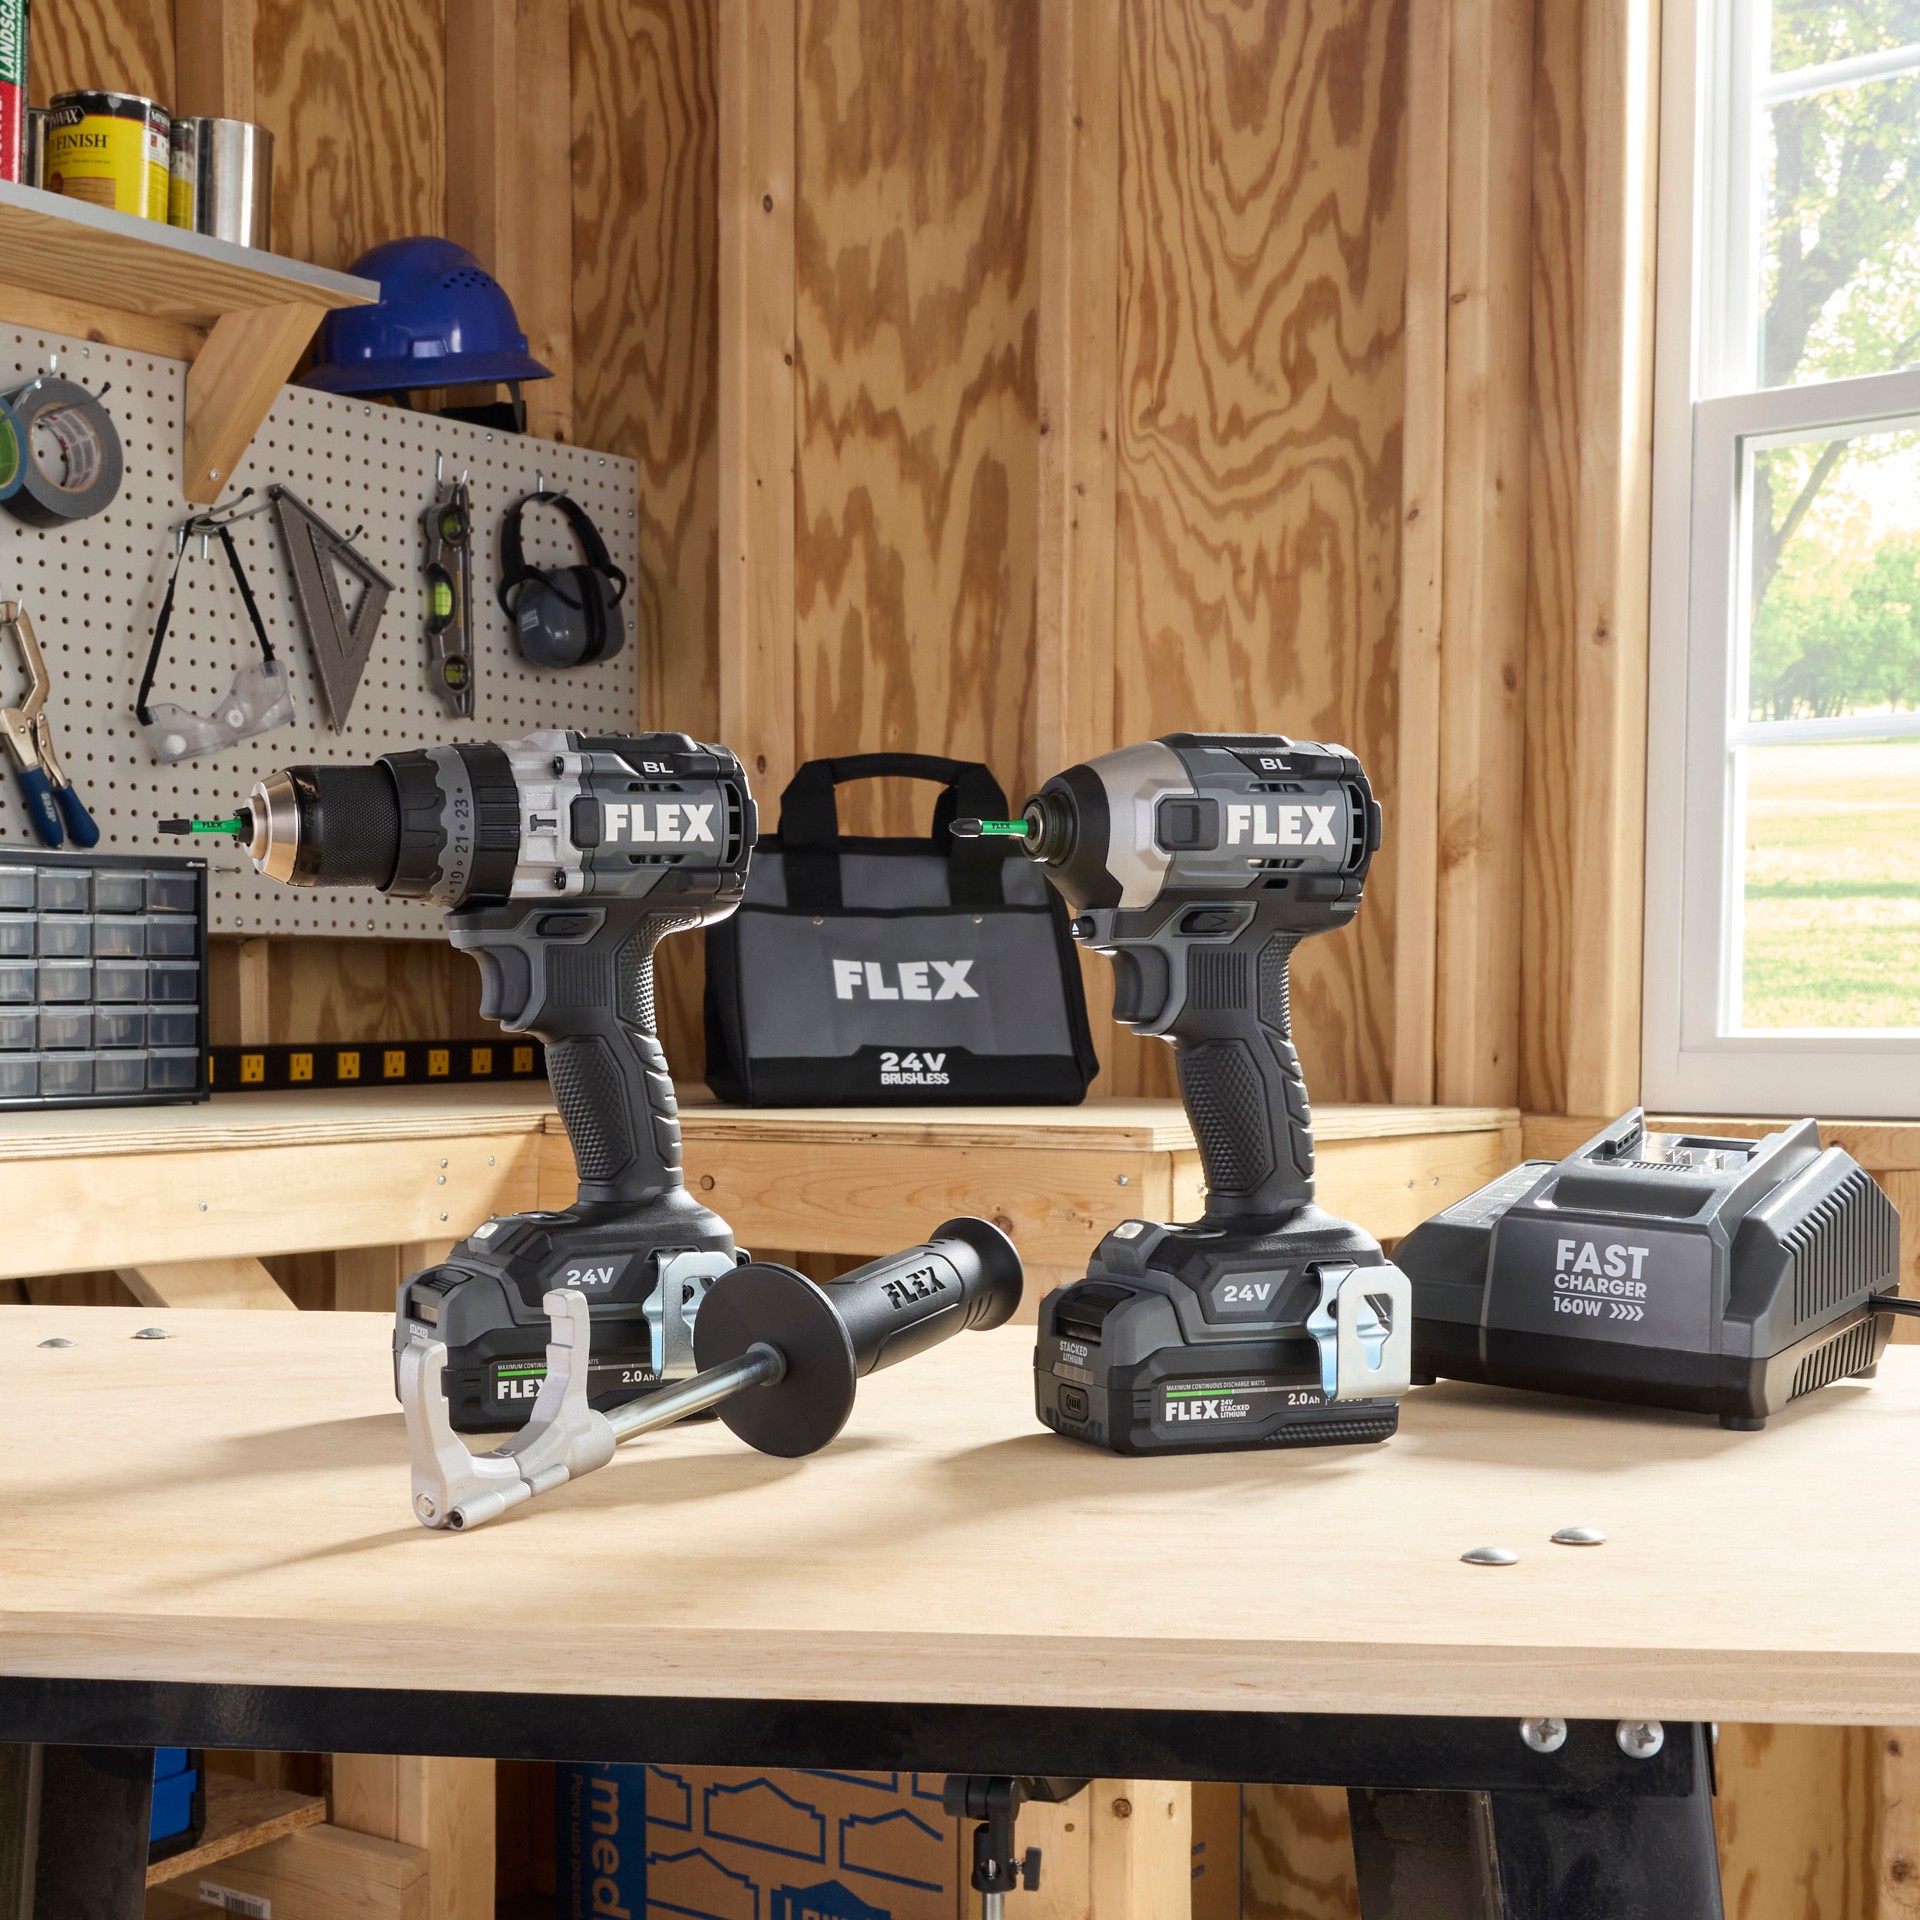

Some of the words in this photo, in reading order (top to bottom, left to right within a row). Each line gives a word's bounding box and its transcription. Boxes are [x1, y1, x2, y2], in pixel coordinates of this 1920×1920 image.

[56, 133, 108, 151] FINISH
[642, 761, 674, 774] BL
[1259, 758, 1292, 771] BL
[454, 799, 469, 818] 23
[201, 821, 223, 829] FLEX
[604, 803, 715, 842] FLEX
[991, 822, 1011, 830] FLEX
[1226, 804, 1337, 846] FLEX
[454, 836, 469, 854] 21
[449, 871, 465, 885] 19
[832, 959, 981, 1001] FLEX
[880, 1052, 947, 1072] 24V
[881, 1072, 950, 1085] BRUSHLESS
[1555, 1239, 1650, 1280] FAST
[566, 1267, 614, 1286] 24V
[881, 1266, 946, 1311] FLEX
[1223, 1283, 1271, 1303] 24V
[1554, 1273, 1648, 1299] CHARGER
[1553, 1296, 1603, 1317] 160W
[409, 1323, 429, 1339] STACKED
[1060, 1340, 1088, 1357] STACKED
[497, 1362, 523, 1371] MAXIMUM
[1062, 1352, 1084, 1366] LITHIUM
[1192, 1382, 1223, 1390] CONTINUOUS
[1223, 1380, 1250, 1388] DISCHARGE
[1165, 1399, 1220, 1422] FLEX
[1220, 1404, 1250, 1412] STACKED
[1220, 1411, 1247, 1419] LITHIUM
[591, 1777, 632, 1920] med
[570, 1859, 584, 1920] pesad
